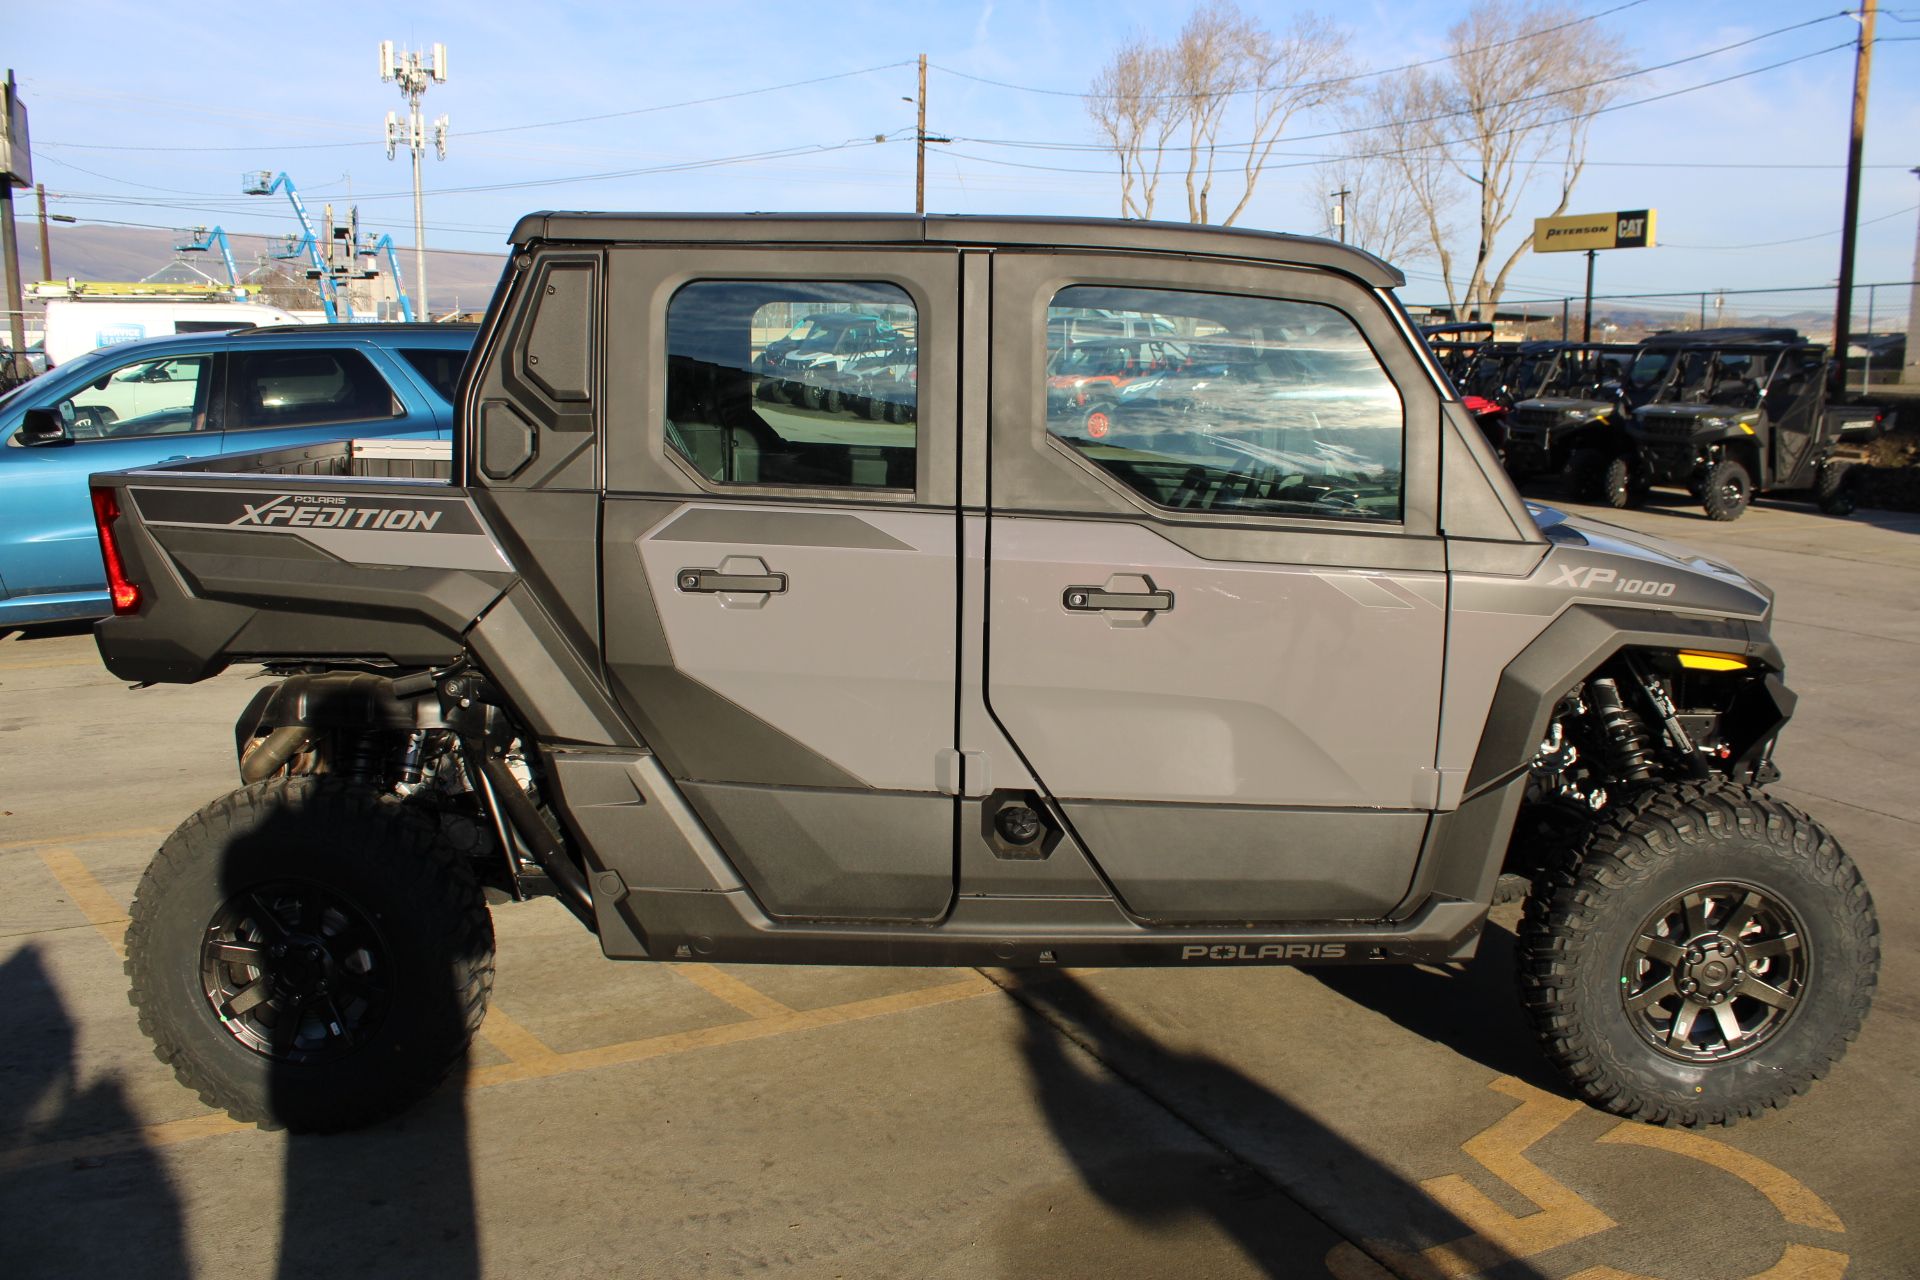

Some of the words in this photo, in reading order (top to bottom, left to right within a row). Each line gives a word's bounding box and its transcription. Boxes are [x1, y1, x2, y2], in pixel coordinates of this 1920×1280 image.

[1617, 218, 1644, 238] CAT
[294, 495, 346, 504] POLARIS
[229, 495, 443, 531] XPEDITION
[1546, 564, 1618, 589] XP
[1615, 578, 1677, 597] 1000
[1181, 943, 1347, 960] POLARIS
